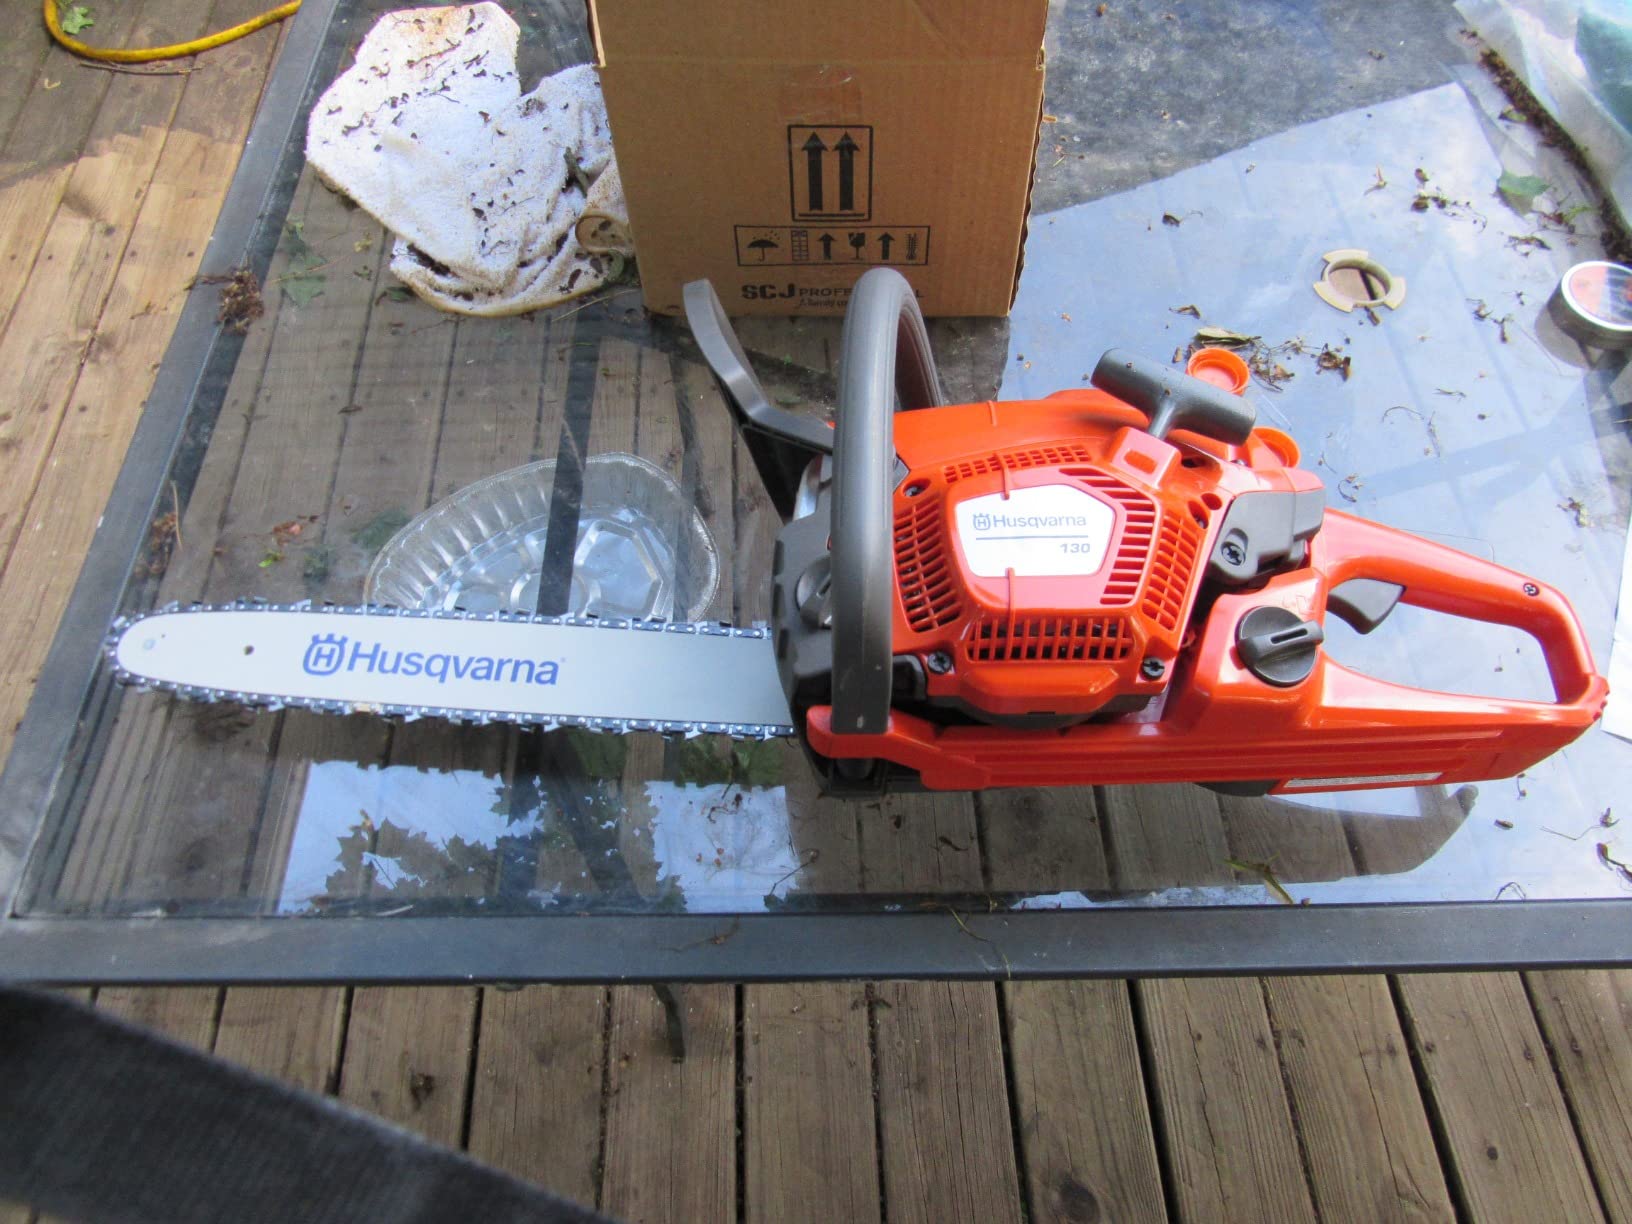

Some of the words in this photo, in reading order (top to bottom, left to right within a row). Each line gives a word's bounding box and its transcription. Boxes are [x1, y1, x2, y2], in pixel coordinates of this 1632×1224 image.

[741, 283, 795, 299] SCJ
[993, 515, 1086, 528] Husqvarna
[1060, 543, 1090, 553] 130
[347, 641, 559, 685] Husqvarna
